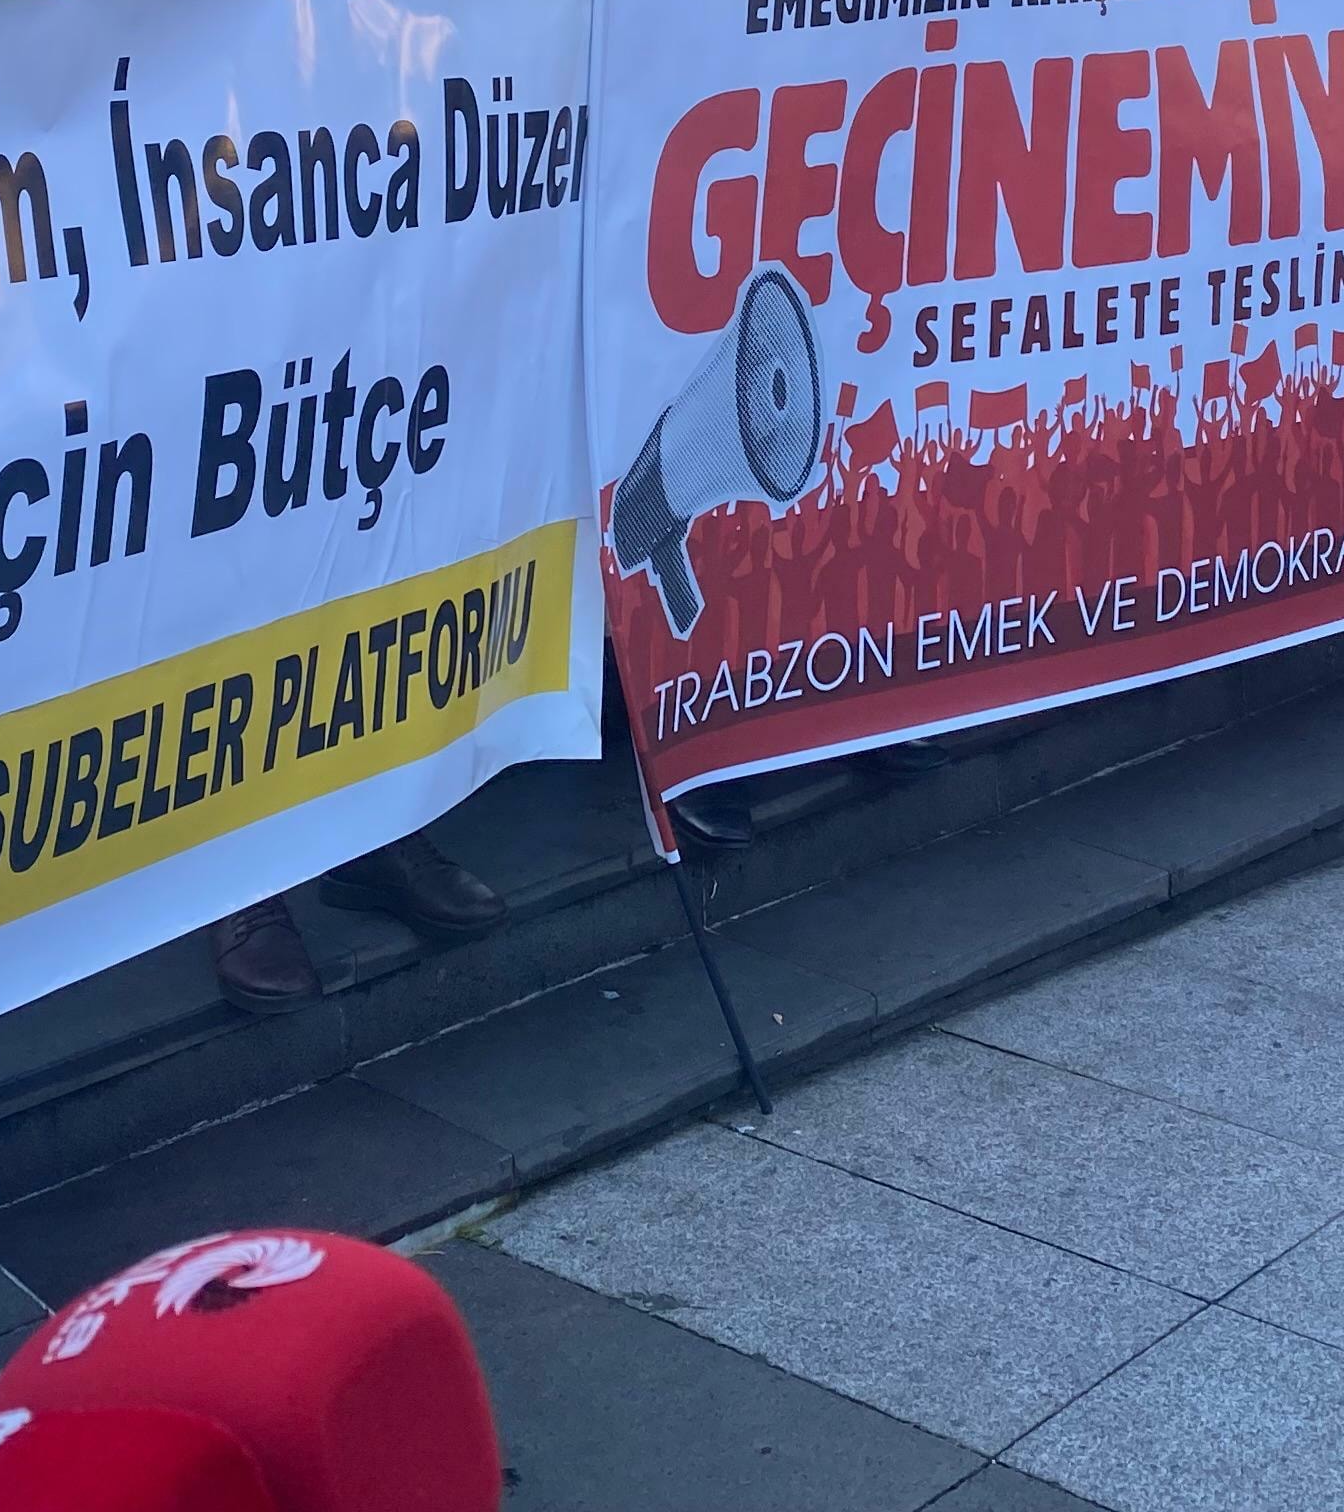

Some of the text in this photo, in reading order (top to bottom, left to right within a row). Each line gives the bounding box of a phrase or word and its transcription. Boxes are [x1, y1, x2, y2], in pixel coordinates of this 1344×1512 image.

[110, 56, 420, 267] İnsanca
[913, 276, 1181, 368] SEFALETE
[191, 346, 450, 539] Bütçe
[262, 560, 538, 773] PLATFORMU
[654, 621, 896, 744] TRABZON
[916, 589, 1060, 672] EMEK
[1074, 576, 1137, 640] VE
